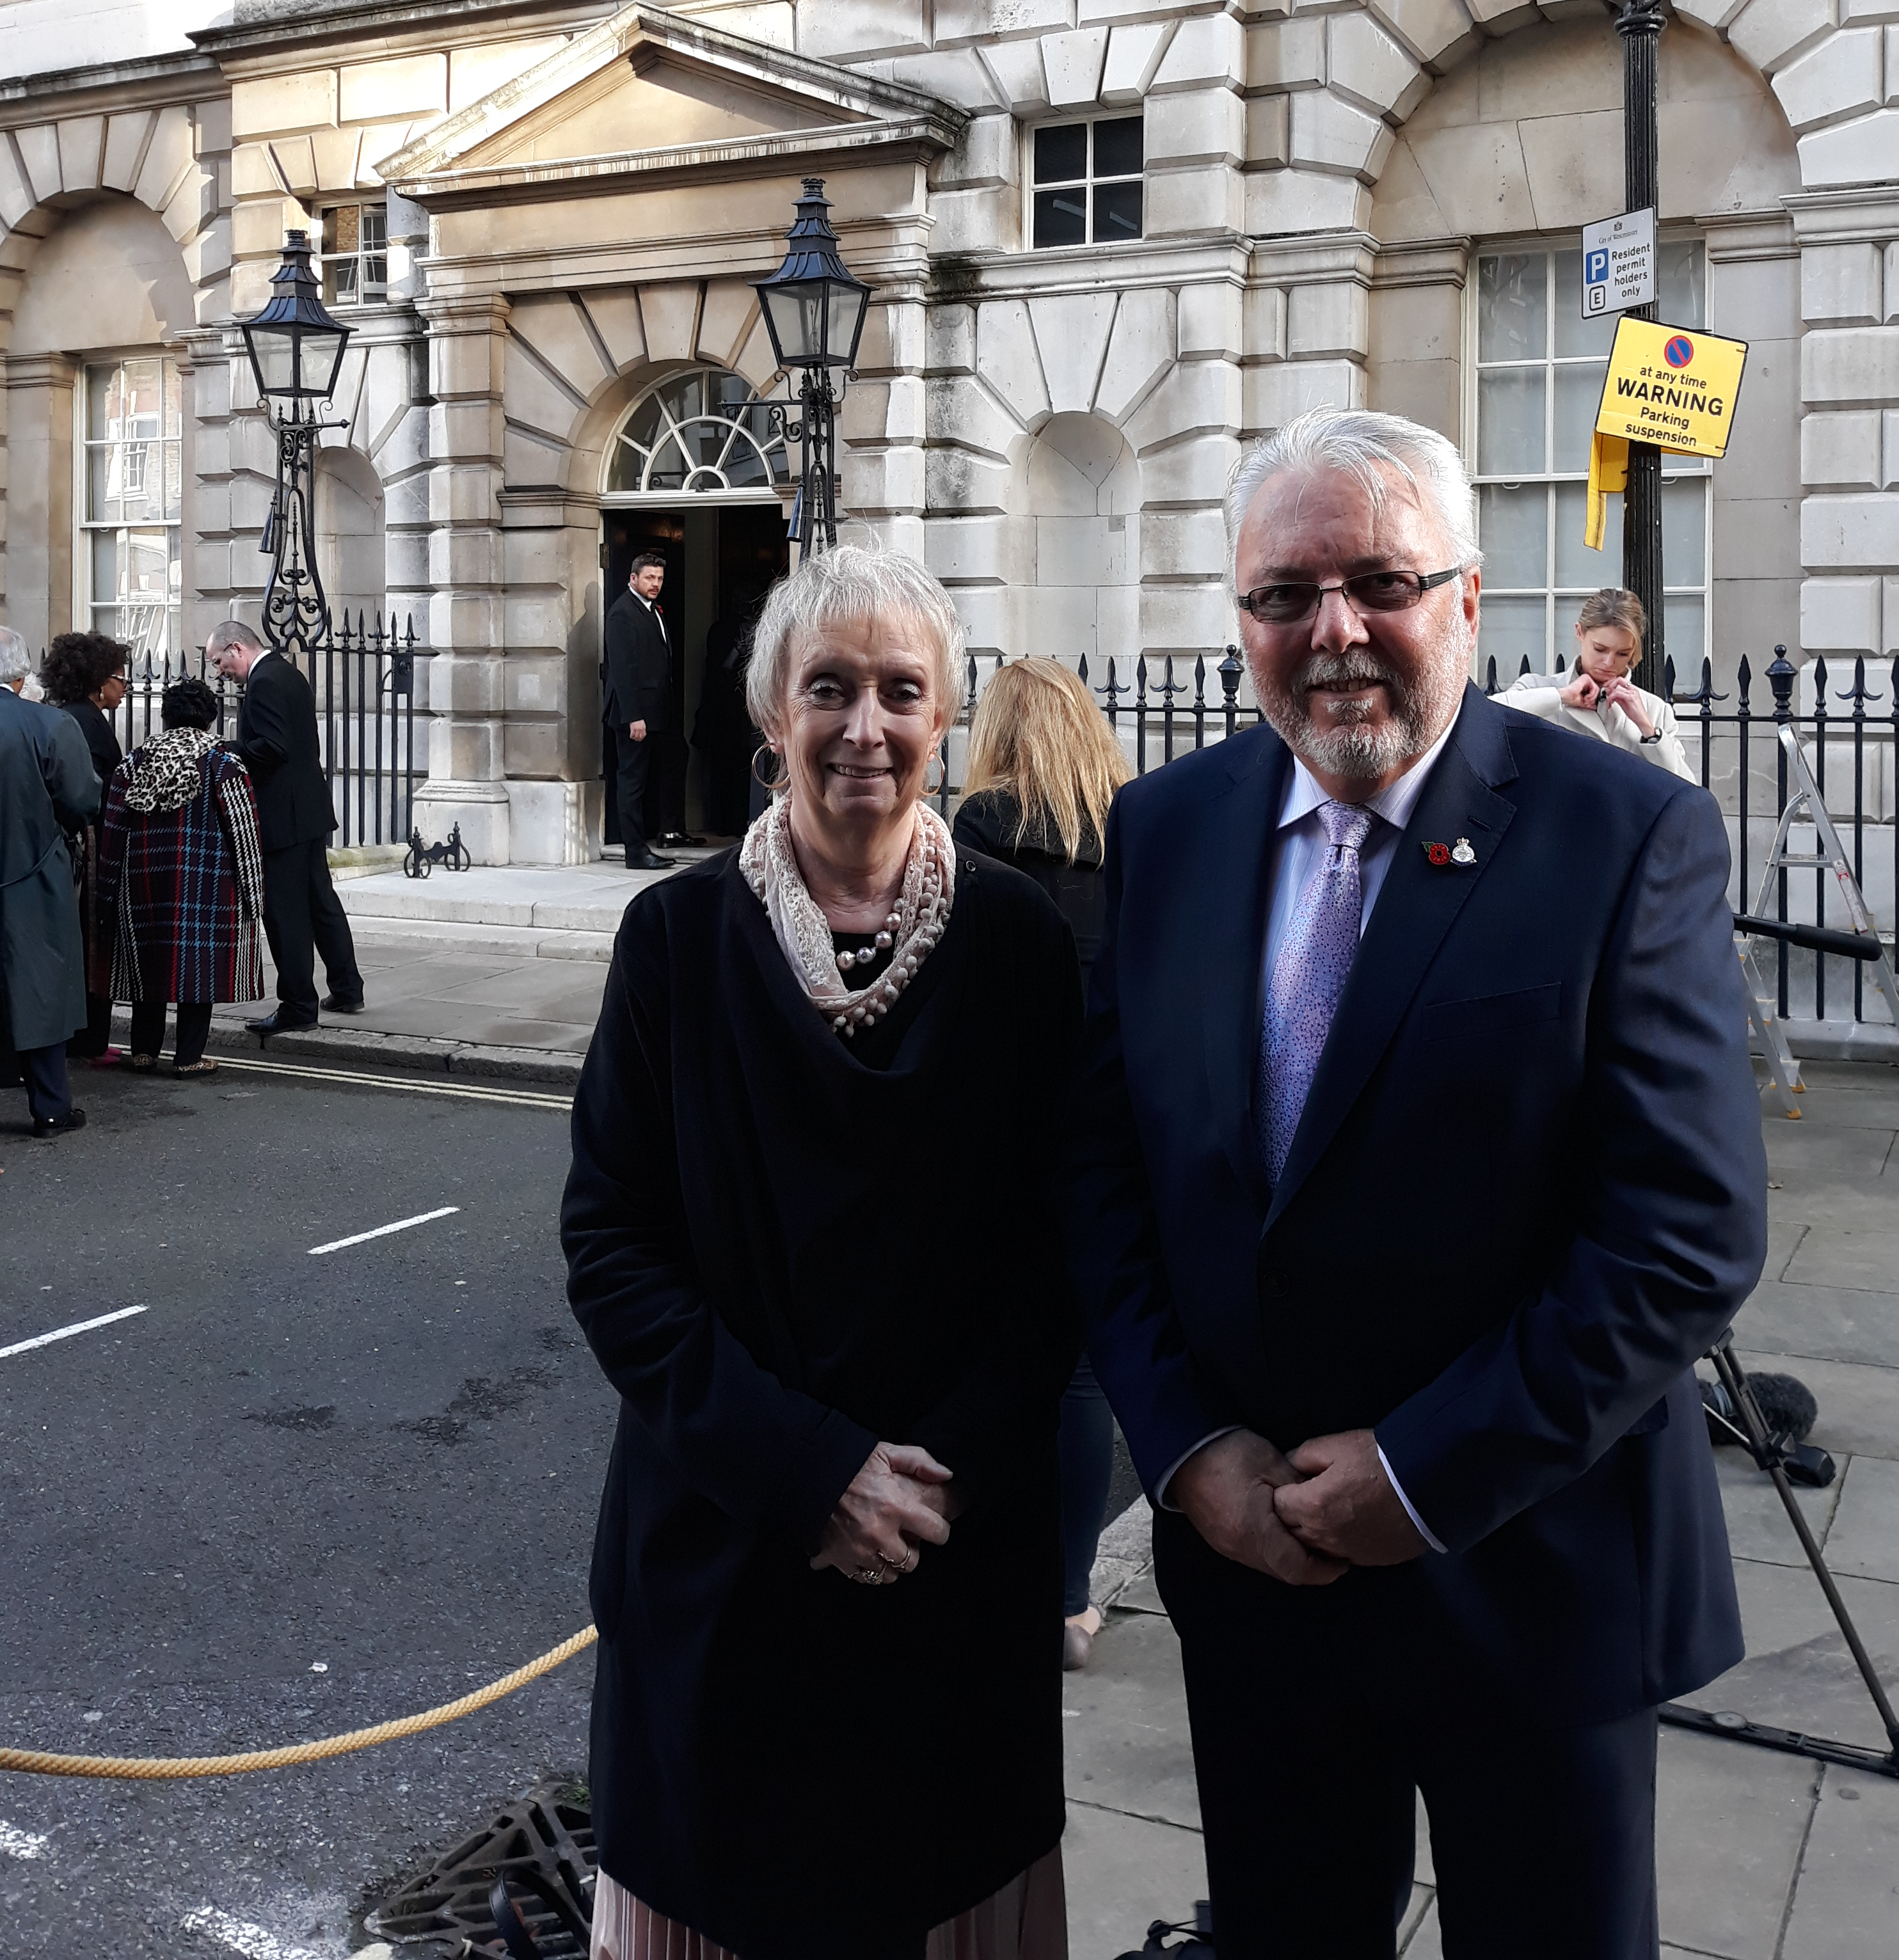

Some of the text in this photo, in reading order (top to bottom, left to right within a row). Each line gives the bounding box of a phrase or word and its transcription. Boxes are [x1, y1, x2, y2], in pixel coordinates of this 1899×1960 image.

[1612, 243, 1650, 260] Resident
[1592, 253, 1605, 280] P
[1617, 257, 1646, 274] permit
[1615, 271, 1648, 286] holders
[1594, 292, 1600, 304] E
[1622, 285, 1640, 297] only
[1640, 367, 1706, 388] at any time
[1617, 377, 1723, 416] WARNING
[1641, 407, 1690, 429] Parking
[1626, 423, 1696, 446] suspension
